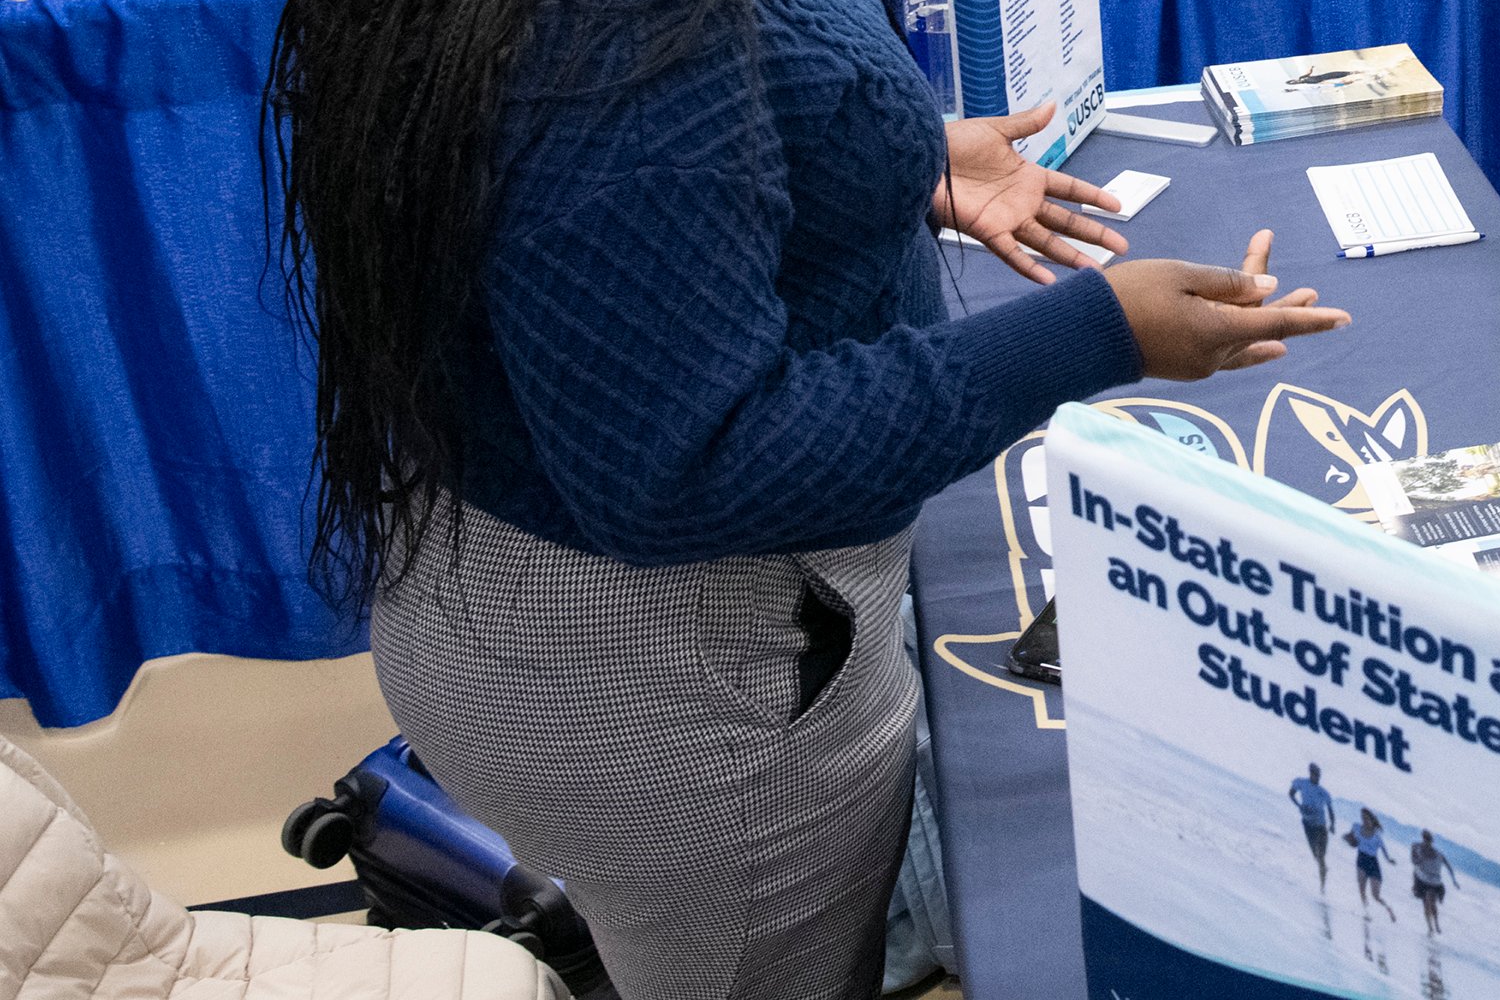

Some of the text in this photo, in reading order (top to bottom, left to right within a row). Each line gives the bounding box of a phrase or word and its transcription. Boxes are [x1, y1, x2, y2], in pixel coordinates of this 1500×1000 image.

[1075, 83, 1104, 126] USCB
[1068, 471, 1274, 597] In-State
[1278, 560, 1477, 684] Tuition
[1107, 556, 1168, 611] an
[1176, 579, 1352, 688] Out-of
[1197, 642, 1413, 774] Student
